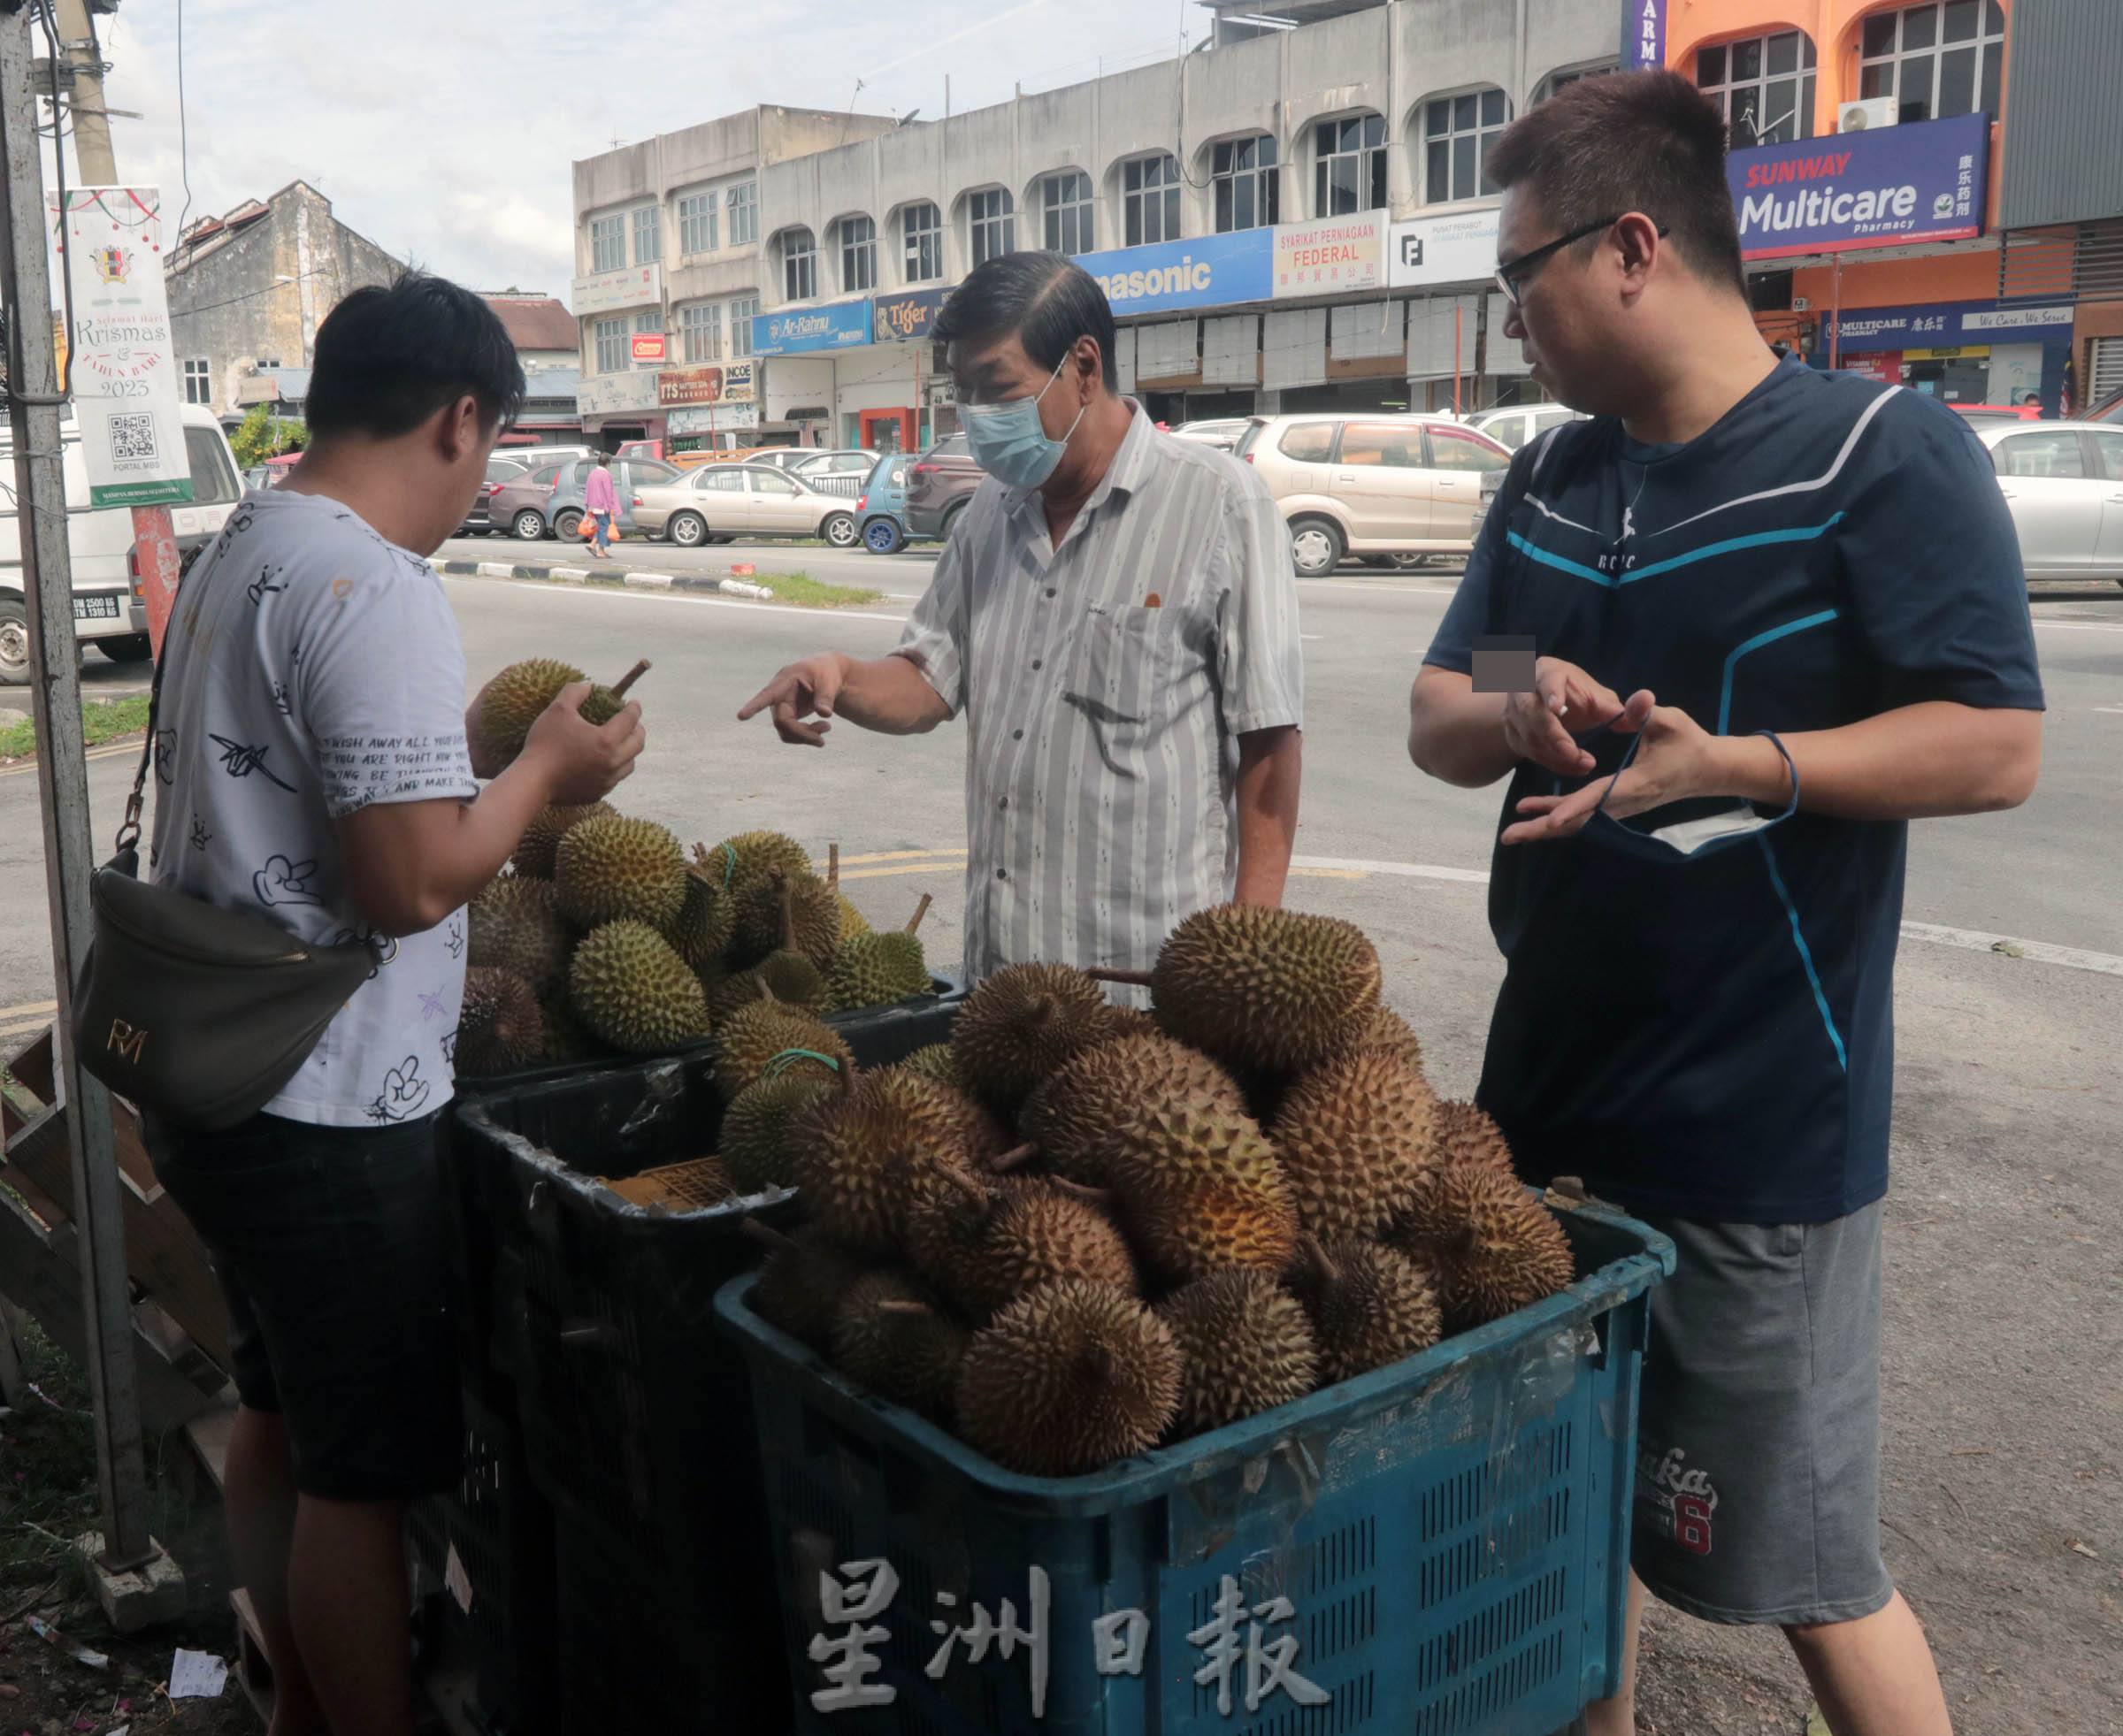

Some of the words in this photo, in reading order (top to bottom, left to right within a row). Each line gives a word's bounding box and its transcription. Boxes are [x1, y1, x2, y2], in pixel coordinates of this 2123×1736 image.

[1745, 152, 1851, 188] SUNWAY
[1739, 186, 1917, 234] Multicare
[1853, 218, 1915, 233] Pharmacy
[1281, 231, 1318, 249] SYARIKAT
[1321, 223, 1374, 242] PERNIAGAAN
[1293, 244, 1360, 268] FEDERAL
[1094, 256, 1211, 301] nasonic
[891, 299, 927, 334] Tiger
[2042, 310, 2066, 323] Serve
[76, 319, 166, 347] Krismas
[783, 316, 829, 335] Ar-Rahnu
[1841, 318, 1907, 333] MULTICARE
[726, 364, 751, 379] INCOE
[102, 380, 149, 397] 2023
[661, 383, 678, 400] TTS
[113, 463, 142, 472] PORTAL
[86, 598, 104, 608] 2500
[105, 597, 115, 607] KG
[88, 608, 105, 617] 1310
[106, 607, 117, 616] KG
[368, 738, 402, 749] AWAY
[405, 737, 428, 749] ALL
[362, 753, 389, 765] ARE
[395, 752, 432, 764] RIGHT
[371, 770, 389, 781] BE
[395, 779, 420, 793] AND
[425, 777, 454, 788] MAKE
